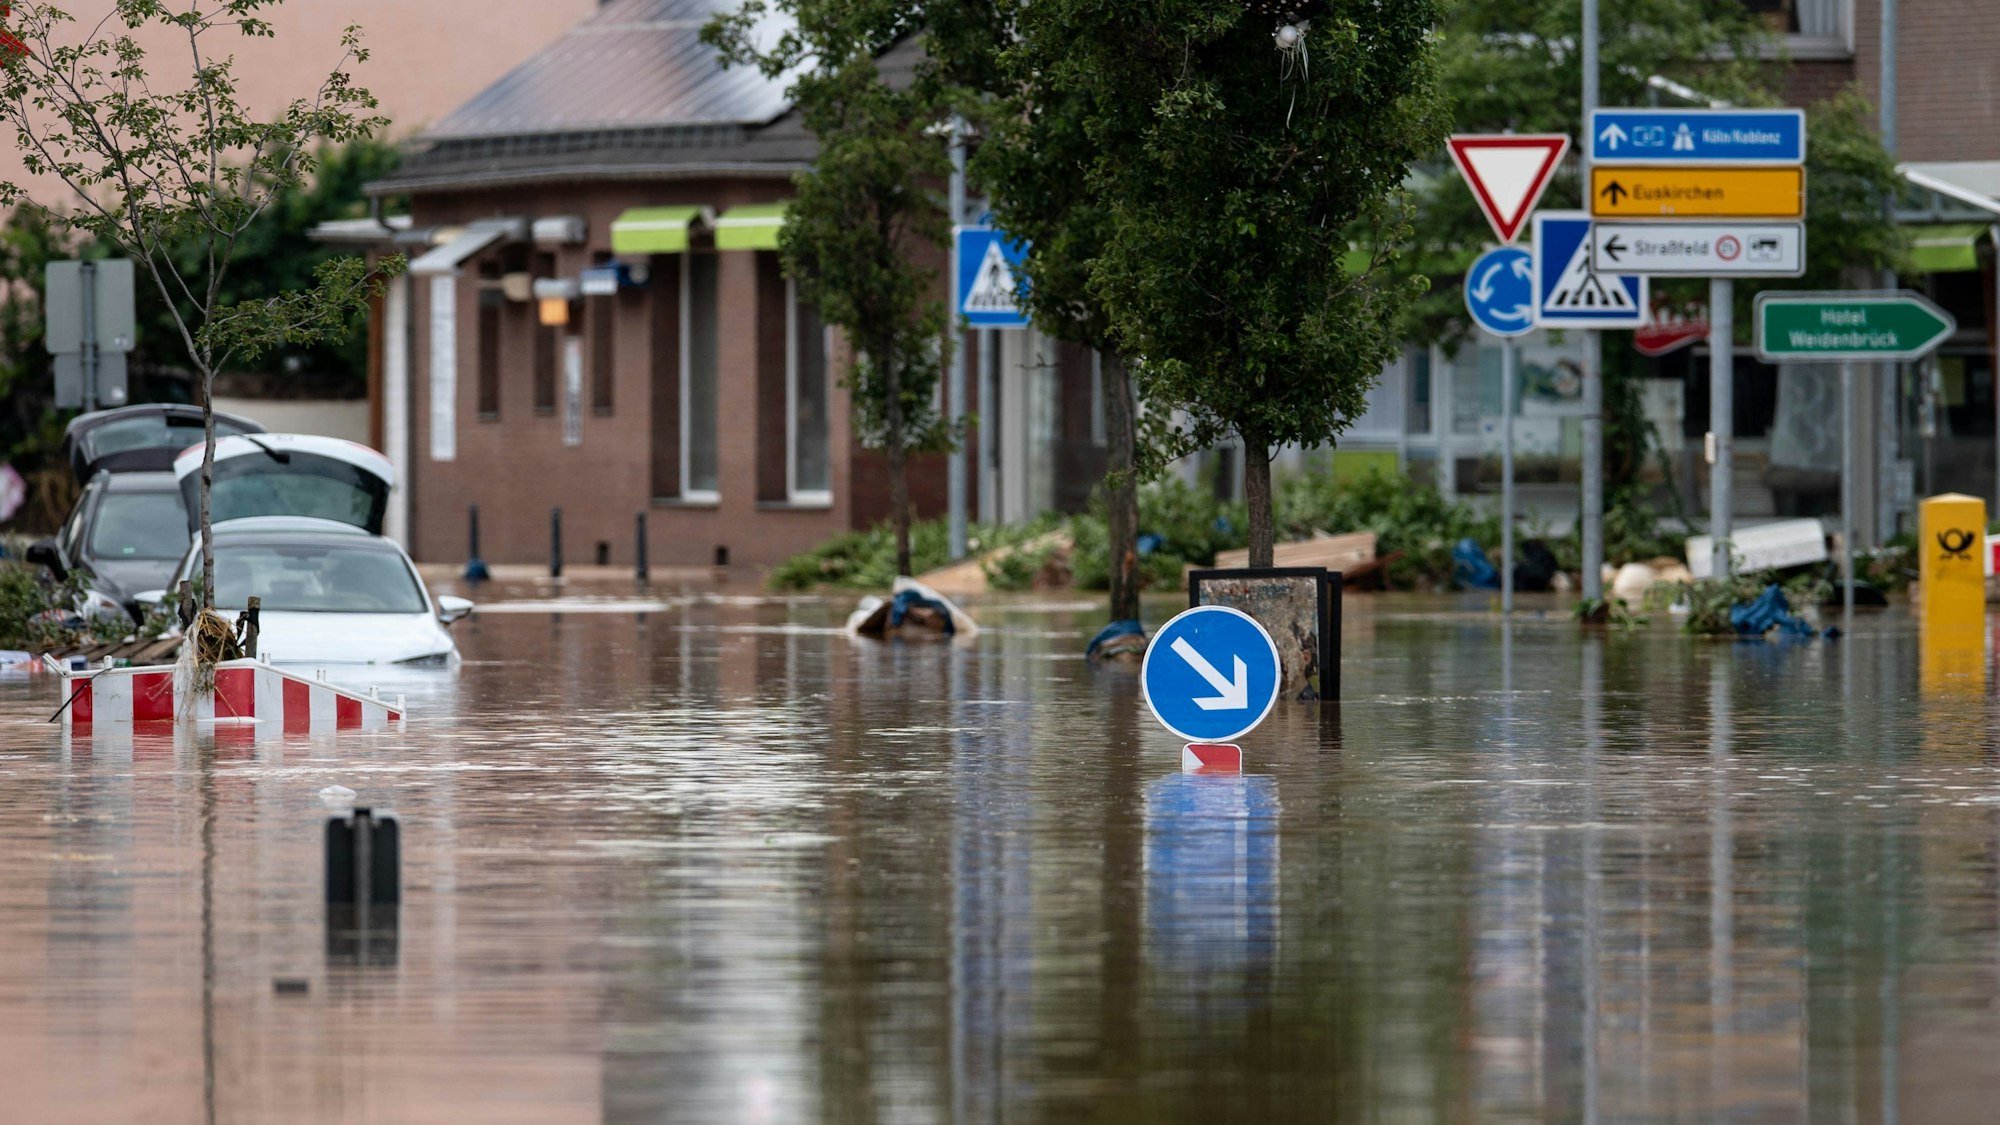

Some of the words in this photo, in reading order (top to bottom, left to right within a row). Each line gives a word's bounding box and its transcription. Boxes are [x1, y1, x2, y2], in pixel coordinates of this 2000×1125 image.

[1632, 184, 1724, 200] Euskirchen
[1635, 239, 1709, 256] Straßfeld
[1821, 309, 1866, 325] Hotel
[1789, 330, 1897, 348] Weidenbrück
